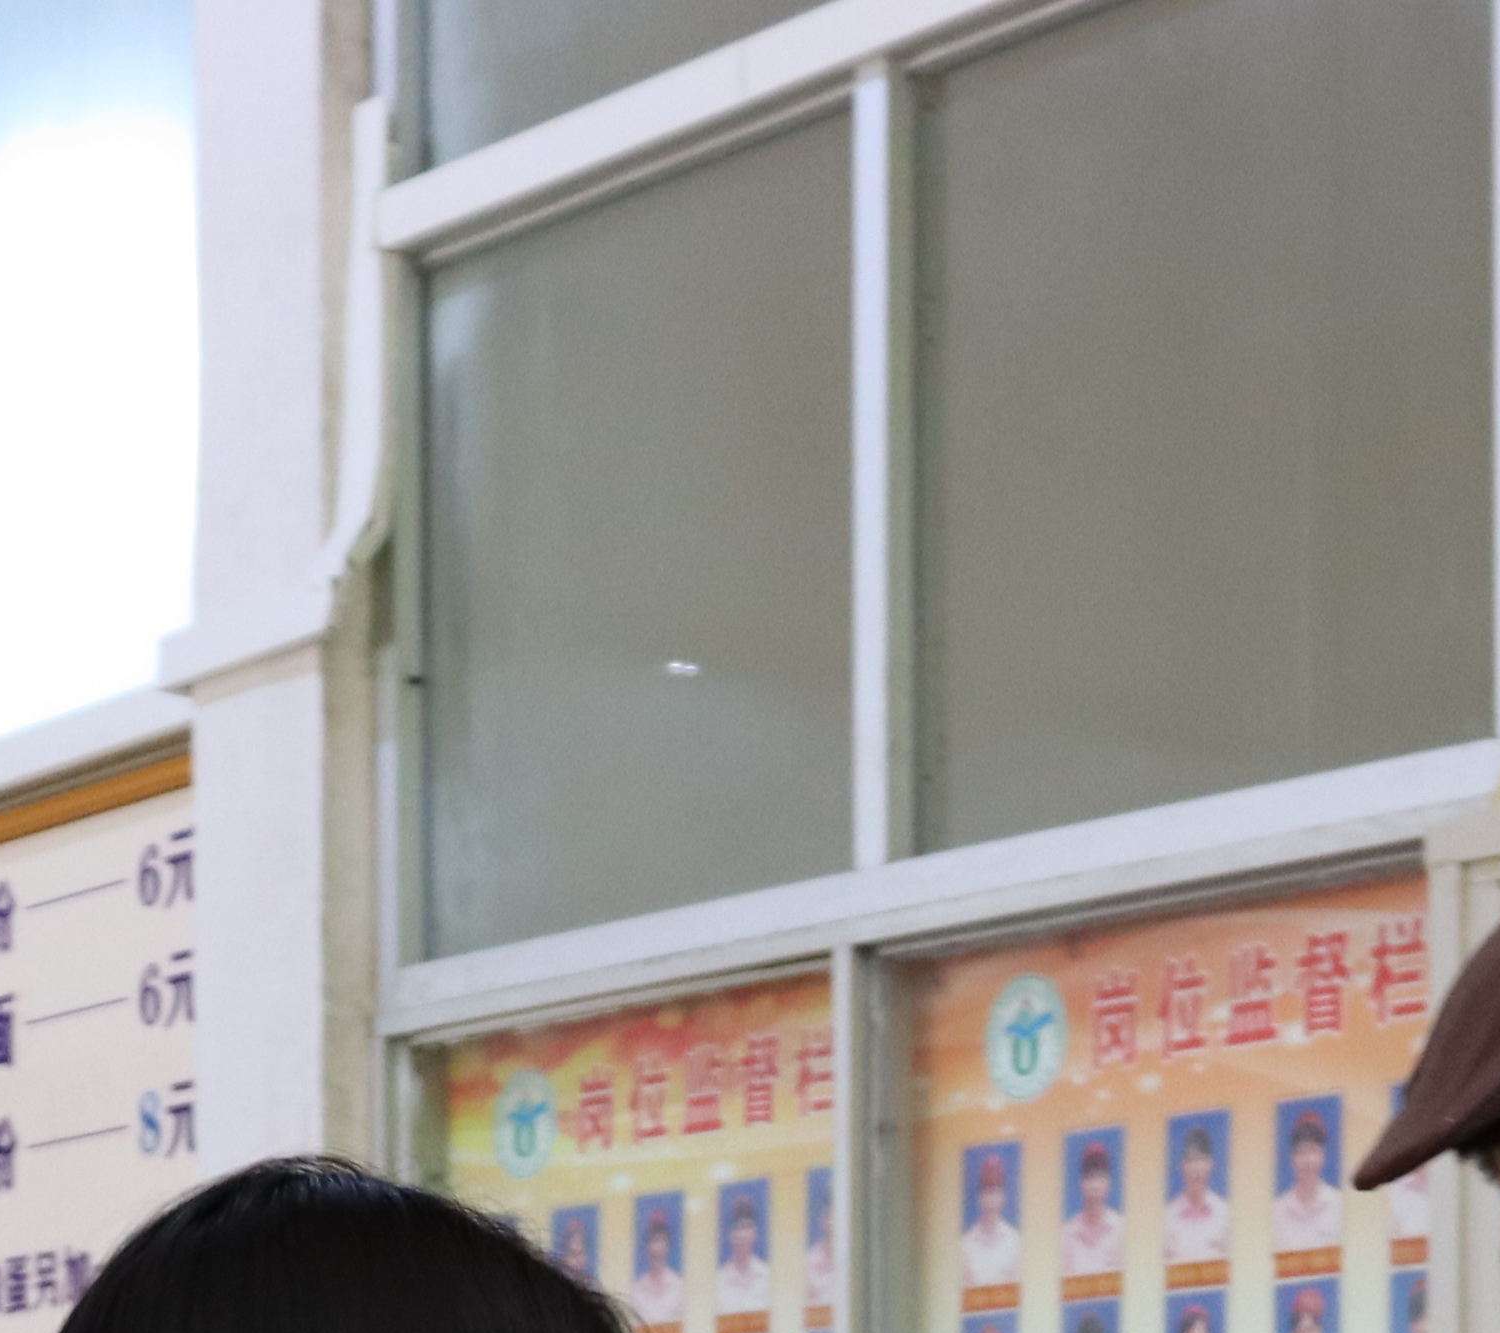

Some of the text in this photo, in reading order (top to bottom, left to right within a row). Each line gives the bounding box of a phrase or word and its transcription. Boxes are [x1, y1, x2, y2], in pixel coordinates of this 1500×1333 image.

[138, 828, 195, 908] 6元
[138, 950, 195, 1028] 6元
[1092, 918, 1428, 1070] 岗位监督栏
[138, 1080, 196, 1158] 8元
[577, 1033, 834, 1152] 岗位监督栏
